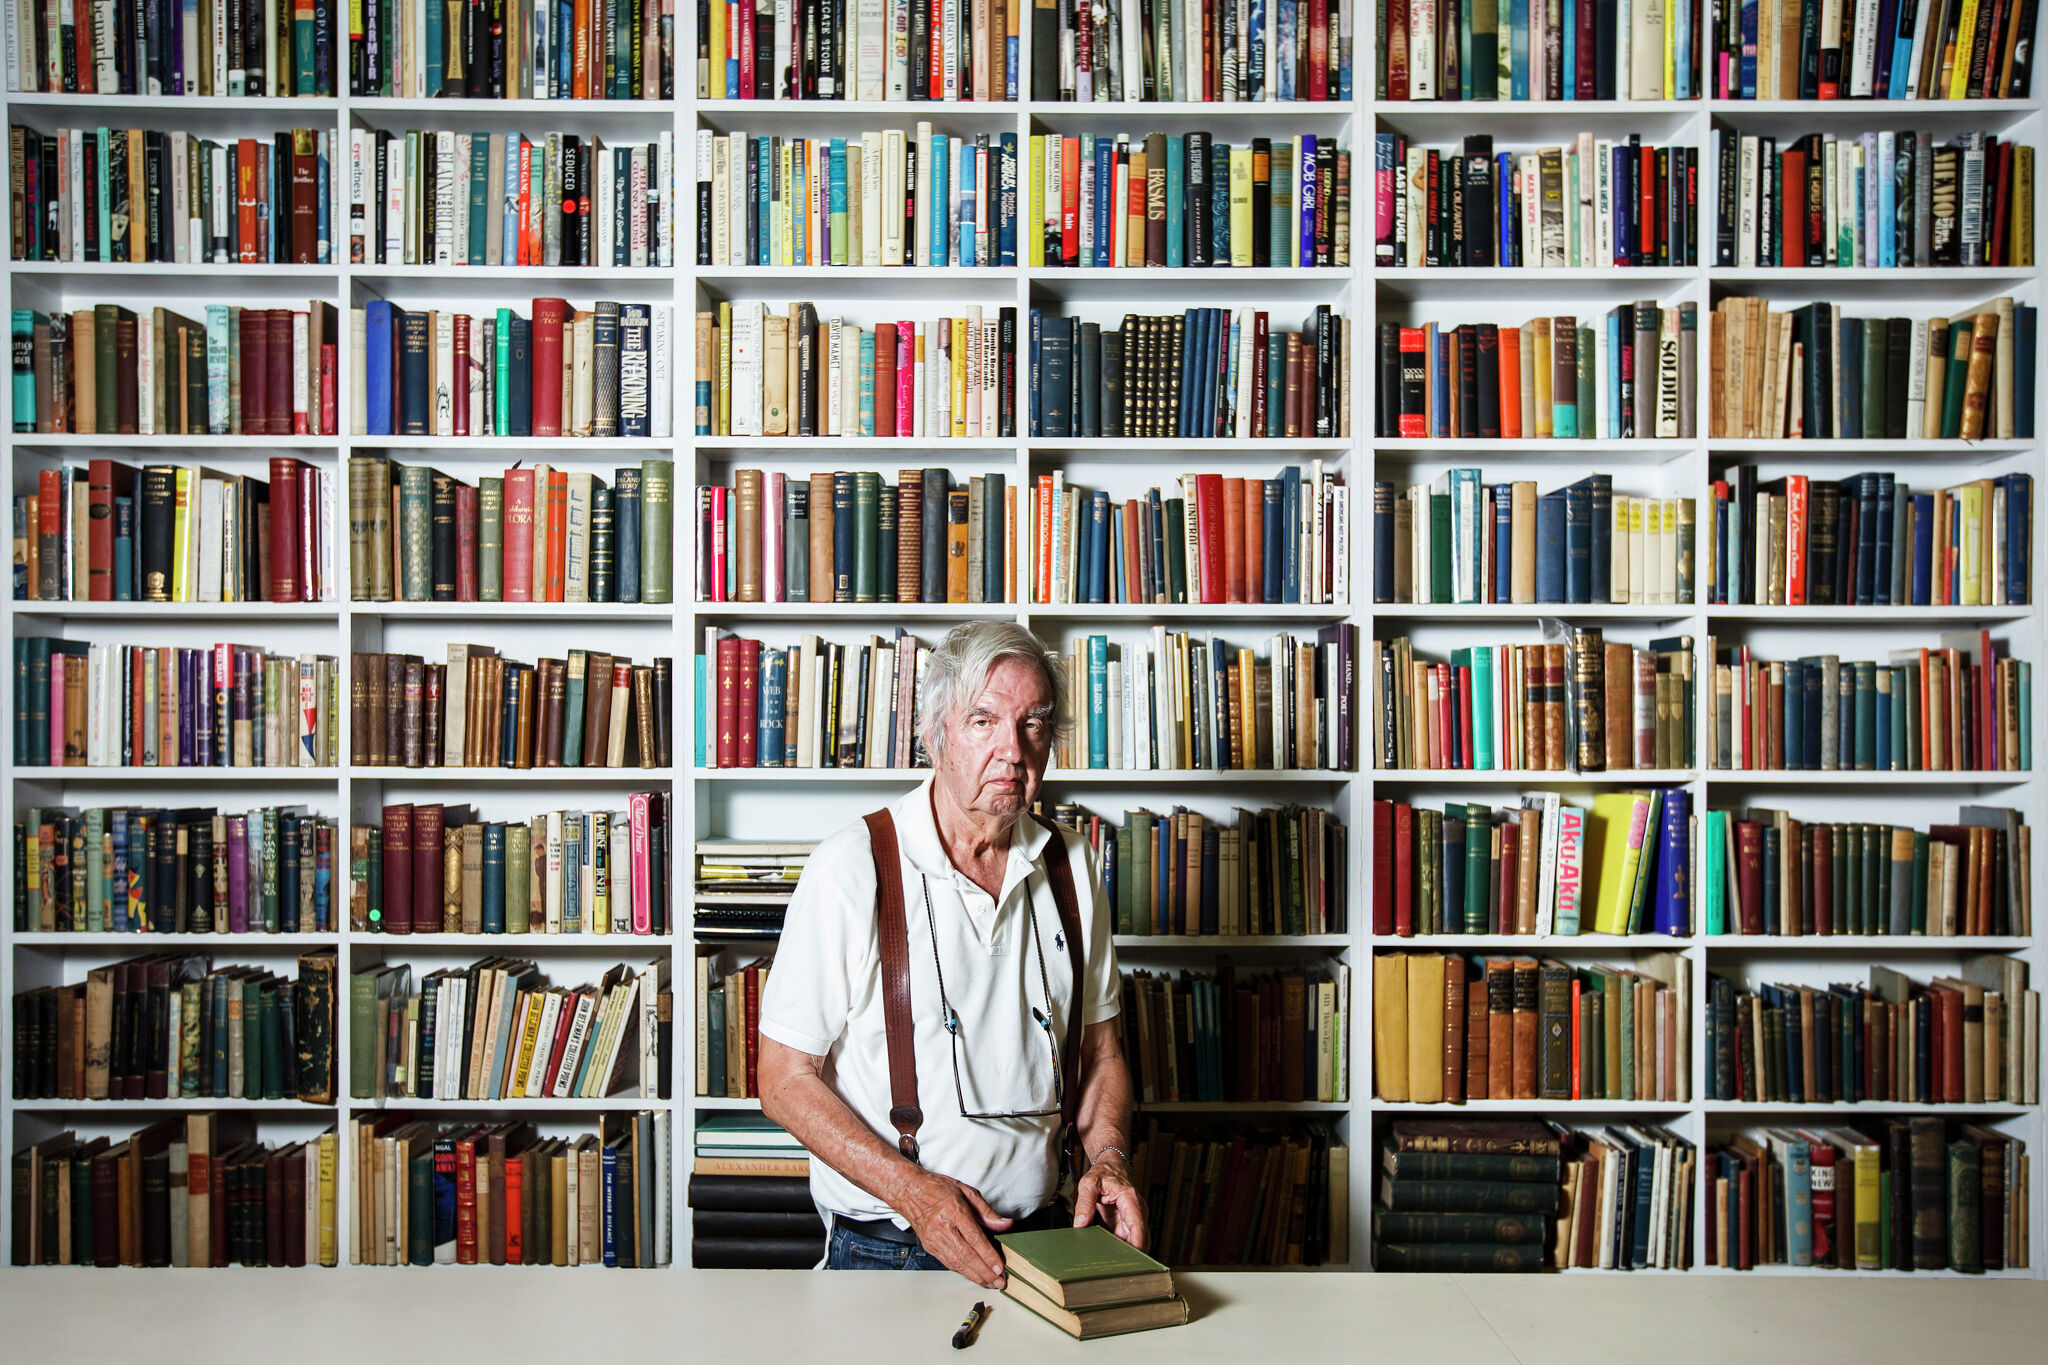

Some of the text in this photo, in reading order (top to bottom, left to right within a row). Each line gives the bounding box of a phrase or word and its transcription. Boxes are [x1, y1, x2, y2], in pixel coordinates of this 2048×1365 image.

[316, 8, 326, 45] OPAL
[897, 15, 907, 33] DID
[945, 2, 956, 75] CARLSON'S RAID
[1081, 7, 1090, 70] The Jew Store
[1331, 13, 1339, 72] BEYOND BEEF
[1864, 2, 1877, 71] MORAL ANIMAL
[1973, 9, 1991, 80] MASK COMMAND
[7, 34, 16, 71] ARCHER
[821, 38, 831, 73] STORM
[932, 31, 941, 77] MONSTERS
[994, 15, 1005, 94] DOROTHY'S WORLD
[377, 146, 385, 170] TALES
[547, 136, 558, 161] Light
[1053, 136, 1061, 147] THE
[1053, 150, 1061, 171] MEDICI
[1190, 134, 1203, 185] NEAL STEPHENSON
[1376, 141, 1385, 172] John James
[351, 143, 366, 199] eyewitness
[507, 135, 519, 191] BARMAN
[520, 147, 531, 195] PRESS GANG
[565, 149, 577, 190] SEDUCED
[1000, 153, 1009, 190] AMERICA
[1008, 158, 1017, 188] HIGH IN
[1302, 152, 1316, 212] MOB GIRL
[1316, 168, 1324, 181] LEE
[1323, 168, 1331, 196] LEGEND
[1384, 142, 1394, 186] The Journal
[1428, 153, 1438, 189] FREE THE
[1813, 166, 1822, 179] THE
[428, 189, 438, 200] Art
[436, 152, 454, 236] ELAINE BILL
[580, 200, 590, 212] 47
[616, 193, 626, 209] Book
[631, 160, 640, 251] GUANO RUSH
[639, 166, 647, 247] THE GREAT
[1000, 192, 1009, 228] Anderson
[1007, 192, 1017, 217] Patrick
[1147, 168, 1165, 220] ERASMUS
[1395, 166, 1406, 243] LAST REFUGE
[1526, 174, 1536, 225] MAN'S HOPE
[1812, 180, 1822, 204] WORLD
[660, 202, 669, 247] David Lida
[717, 189, 727, 257] DIVERSITY OF LIFE
[1065, 212, 1075, 230] Rubin
[1194, 198, 1202, 255] CRYPTONOMICON
[655, 310, 667, 381] SPEAKING OUT
[719, 328, 729, 391] LEISERSON
[829, 318, 841, 370] DAVID MAMET
[989, 327, 997, 388] Bombs Beards
[620, 326, 648, 420] THE RECKONING
[1255, 348, 1265, 414] Semantics and the Body
[1660, 340, 1678, 422] SOLDIER
[831, 375, 839, 416] THE VILLAGE
[1063, 519, 1072, 532] Way
[1064, 534, 1071, 542] of
[762, 685, 781, 696] WEB
[1340, 695, 1348, 716] POET
[759, 719, 784, 729] ROCK
[595, 824, 606, 849] PAUSE
[634, 805, 645, 854] Marcel Proust
[595, 868, 606, 897] DESERT
[1320, 1011, 1331, 1030] Helen
[515, 996, 543, 1089] JOHN BETJEMAN'S COLLECTED POEMS
[557, 999, 590, 1089] JOHN BETJEMAN'S COLLECTED POEMS
[1319, 1037, 1331, 1054] Egypt
[714, 1161, 781, 1173] ALEXANDER
[605, 1171, 613, 1243] THE INTERIOR DISTANCE
